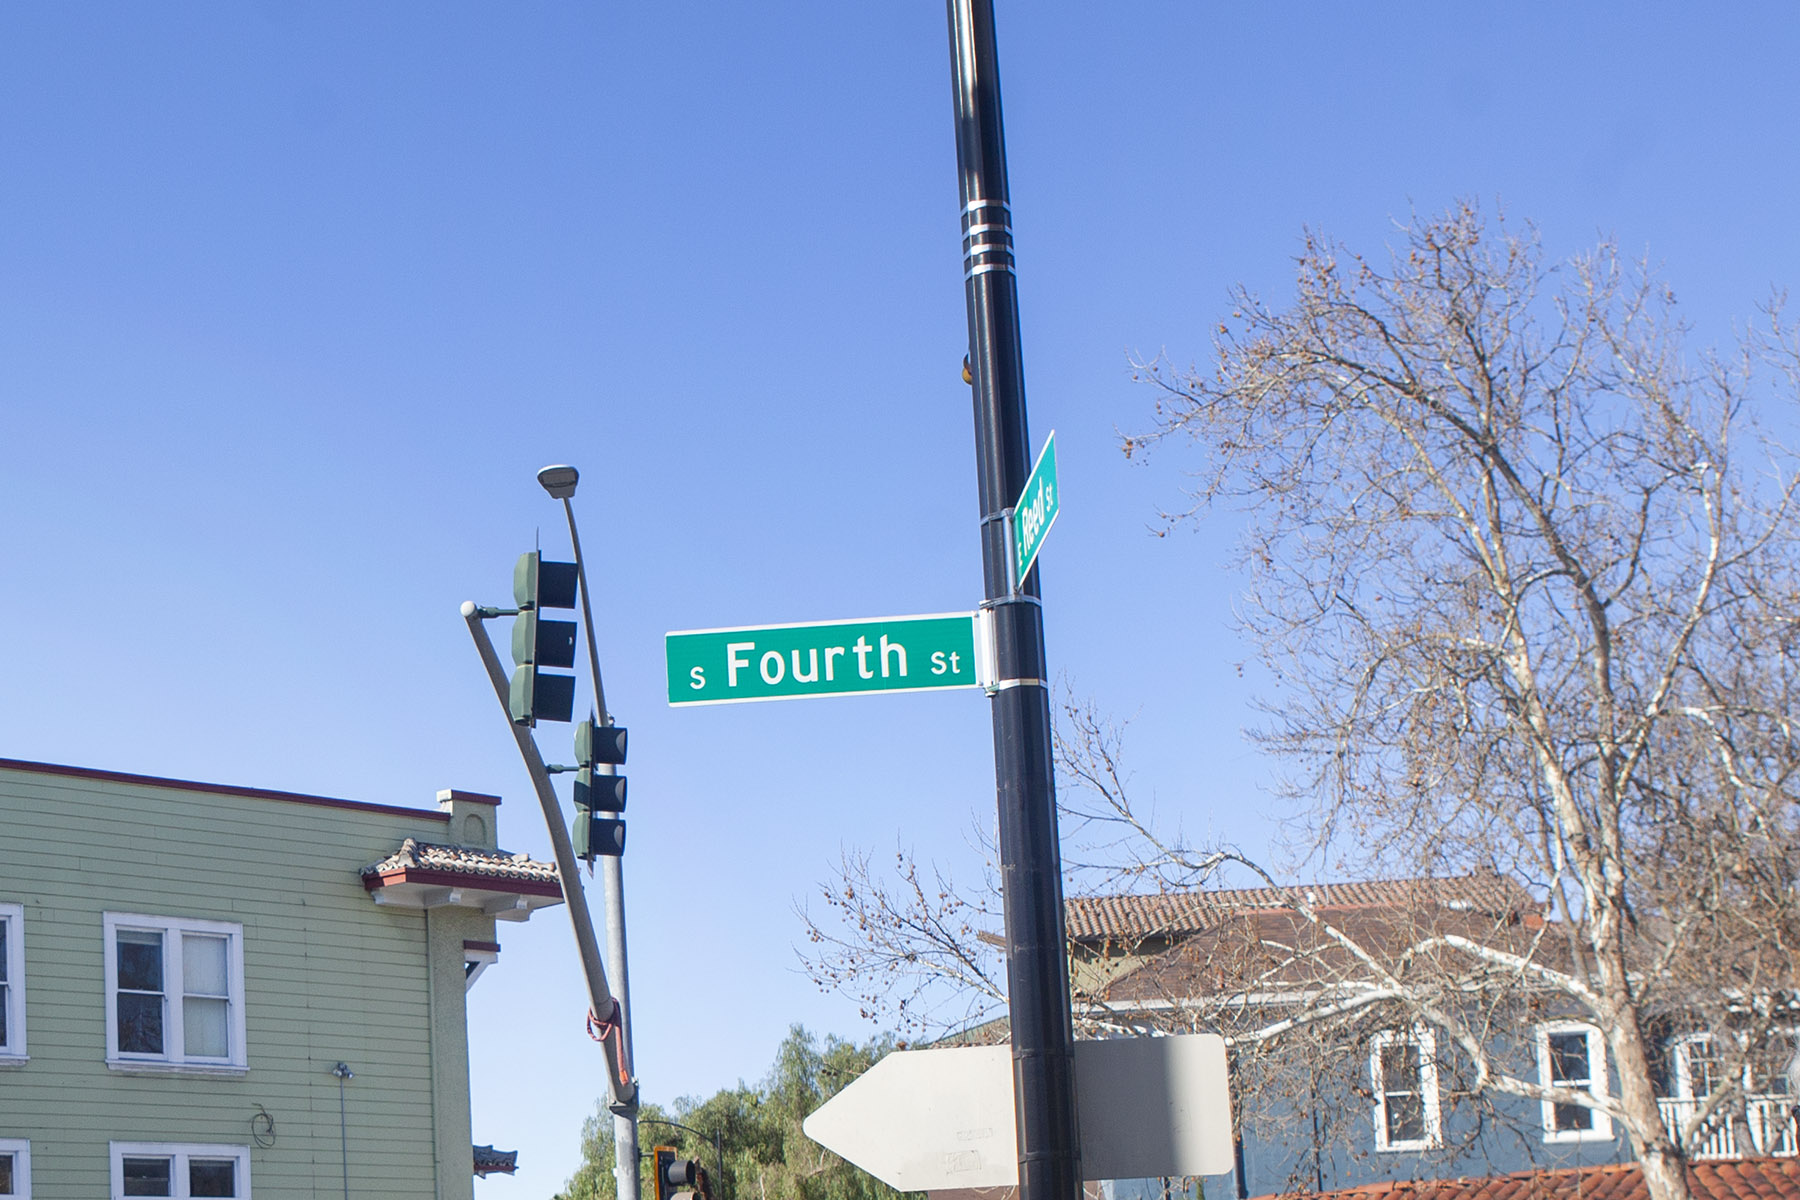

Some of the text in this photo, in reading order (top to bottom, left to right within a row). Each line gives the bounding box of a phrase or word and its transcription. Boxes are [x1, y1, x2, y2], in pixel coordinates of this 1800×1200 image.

[1021, 476, 1045, 556] Reed
[1045, 482, 1054, 512] St
[689, 633, 961, 690] S Fourth St
